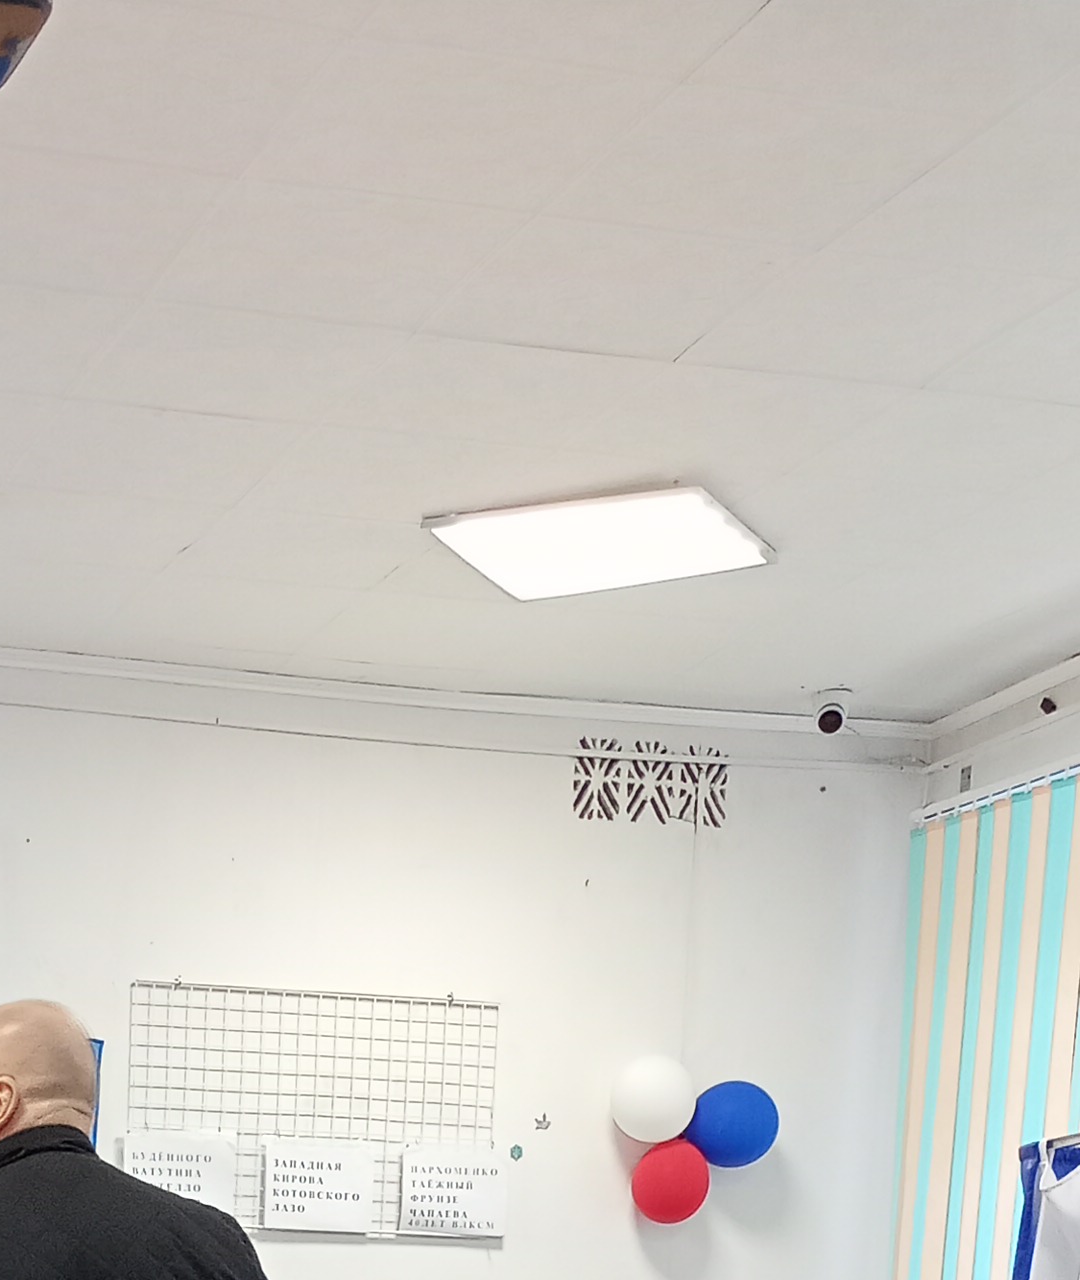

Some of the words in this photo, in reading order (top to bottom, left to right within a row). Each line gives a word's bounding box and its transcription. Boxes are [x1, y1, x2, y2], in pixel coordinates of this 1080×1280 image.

[273, 1158, 342, 1171] ЗАПАДНАЯ
[410, 1165, 499, 1177] ПАРХОМЕНКО
[272, 1173, 324, 1185] КИРОВА
[272, 1188, 360, 1201] КОТОВСКОГО
[409, 1194, 459, 1204] ФРУНЗЕ
[271, 1203, 306, 1213] ЛАЗО
[409, 1208, 468, 1219] ЧАПАЕВА
